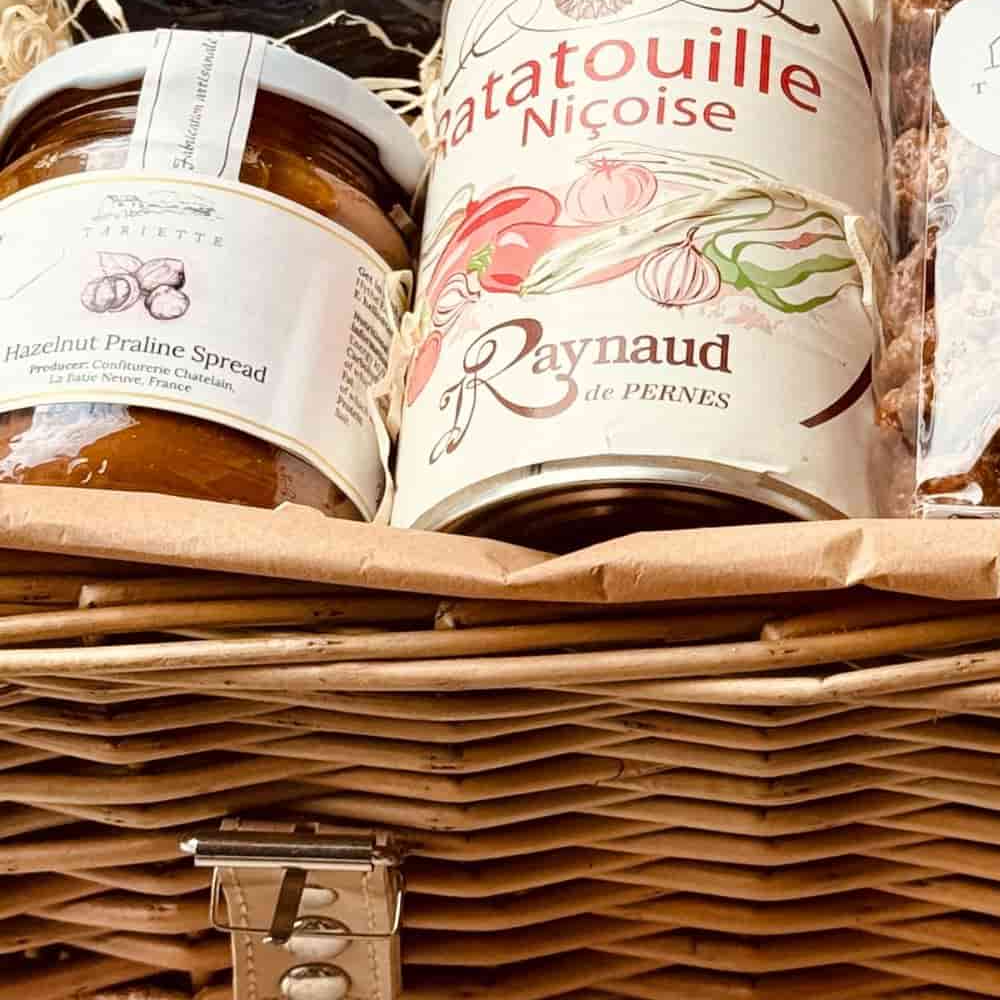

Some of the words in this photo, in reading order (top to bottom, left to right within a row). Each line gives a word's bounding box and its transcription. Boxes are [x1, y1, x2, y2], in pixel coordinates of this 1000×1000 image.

[520, 87, 737, 148] Niçoise
[3, 335, 97, 363] Hazelnut
[103, 333, 186, 359] Praline
[190, 344, 269, 385] Spread
[29, 360, 90, 375] Producer:
[102, 373, 146, 386] Neuve,
[149, 376, 193, 393] France
[430, 316, 734, 465] Raynaud
[583, 381, 615, 403] de
[619, 382, 731, 411] PERNES
